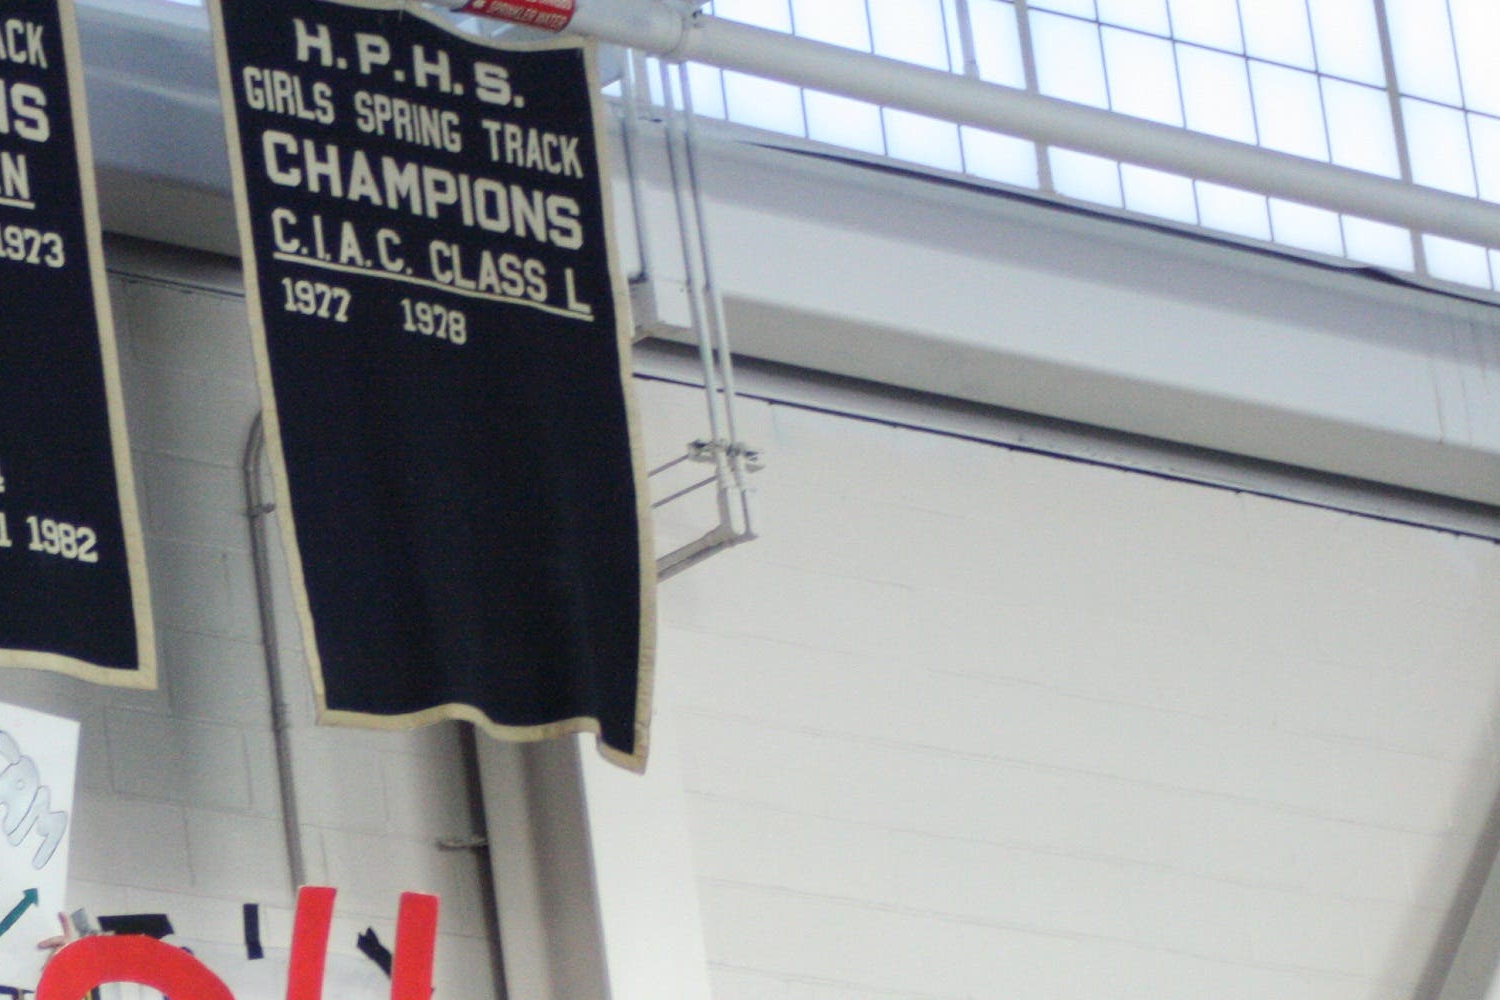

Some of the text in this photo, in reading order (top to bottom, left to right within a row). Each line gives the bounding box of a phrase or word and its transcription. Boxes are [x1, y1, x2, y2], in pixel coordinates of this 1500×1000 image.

[243, 66, 583, 178] GIRLS SPRING TRACK
[263, 129, 583, 250] CHAMPIONS
[282, 277, 467, 345] 1977 1978
[429, 240, 548, 302] CLASS
[565, 268, 591, 313] L
[26, 515, 99, 563] 1982
